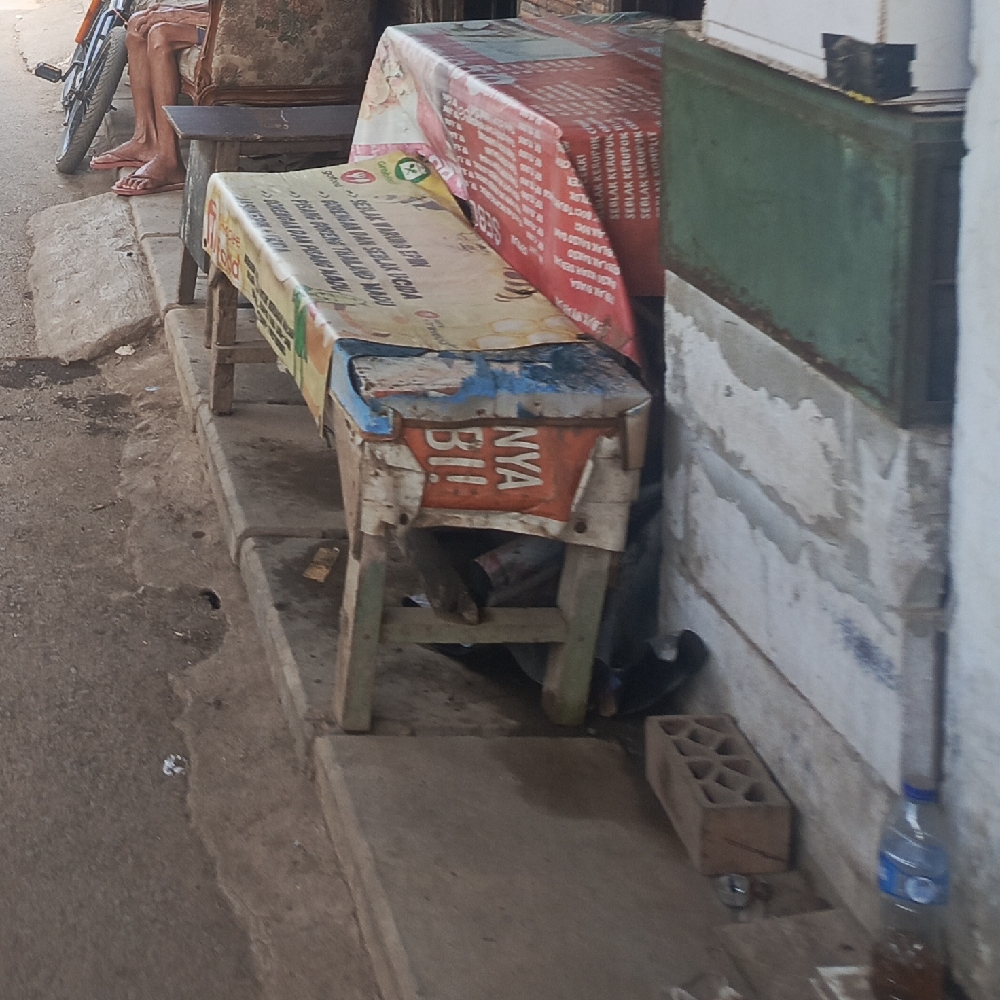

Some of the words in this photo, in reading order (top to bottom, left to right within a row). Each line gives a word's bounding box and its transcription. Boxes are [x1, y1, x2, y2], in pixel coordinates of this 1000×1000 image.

[590, 135, 602, 182] KERUPUK
[605, 133, 618, 180] KERUPUK
[619, 131, 633, 180] KERUPUK
[633, 130, 649, 179] KERUPUK
[608, 181, 620, 220] SEBLAK
[623, 180, 636, 220] SEBLAK
[639, 180, 652, 219] SEBLAK
[287, 229, 313, 247] DAN
[321, 198, 360, 232] GORENGAN
[348, 231, 376, 246] DAN
[363, 246, 401, 273] SEBLAK
[351, 198, 386, 222] SEBLAK
[372, 221, 413, 250] WARUNG
[291, 198, 324, 222] PISANG
[309, 221, 346, 246] GORENG
[359, 281, 398, 307] MADU
[302, 246, 335, 270] PISANG
[318, 269, 353, 293] MADU
[493, 426, 544, 490] NYA
